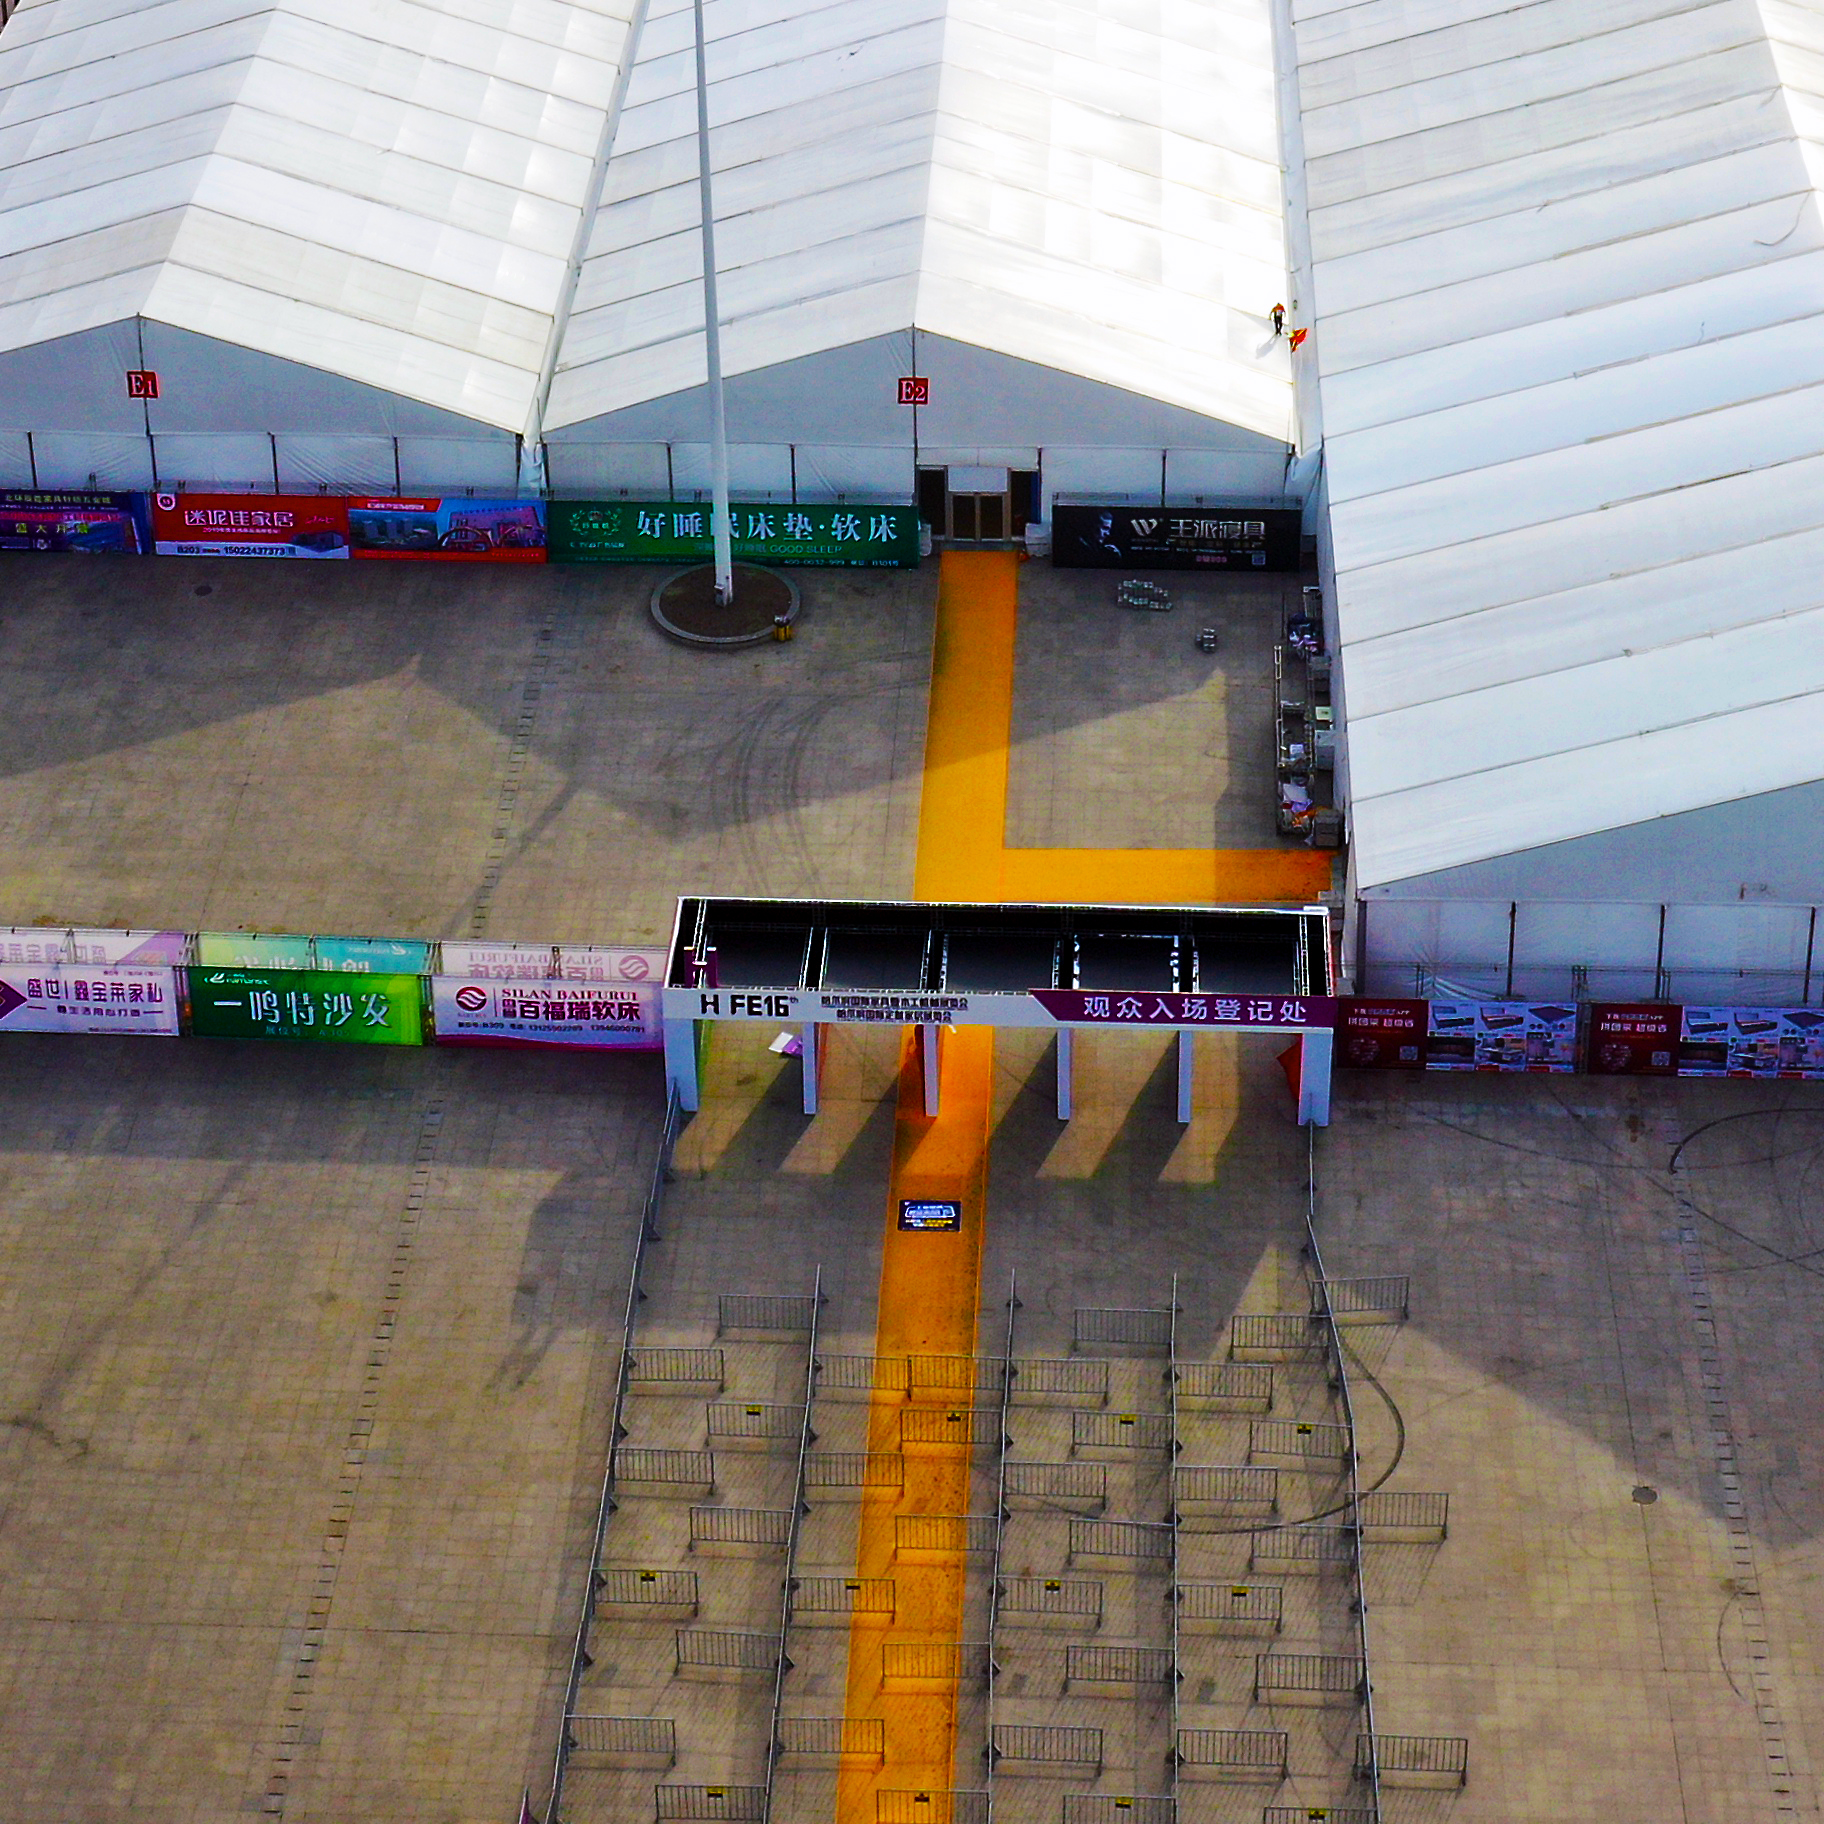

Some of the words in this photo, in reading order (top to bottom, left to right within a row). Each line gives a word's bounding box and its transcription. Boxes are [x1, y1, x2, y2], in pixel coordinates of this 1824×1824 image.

[130, 373, 156, 397] E1
[900, 379, 926, 403] E2
[770, 544, 803, 554] GOOD
[806, 544, 843, 554] SLEEP
[501, 988, 551, 1000] SILAN
[557, 989, 638, 1001] BAIFURUI
[213, 989, 392, 1028] 一鸣特沙发
[518, 999, 641, 1022] 百福瑞软床
[1082, 994, 1308, 1023] 观众入场登记处
